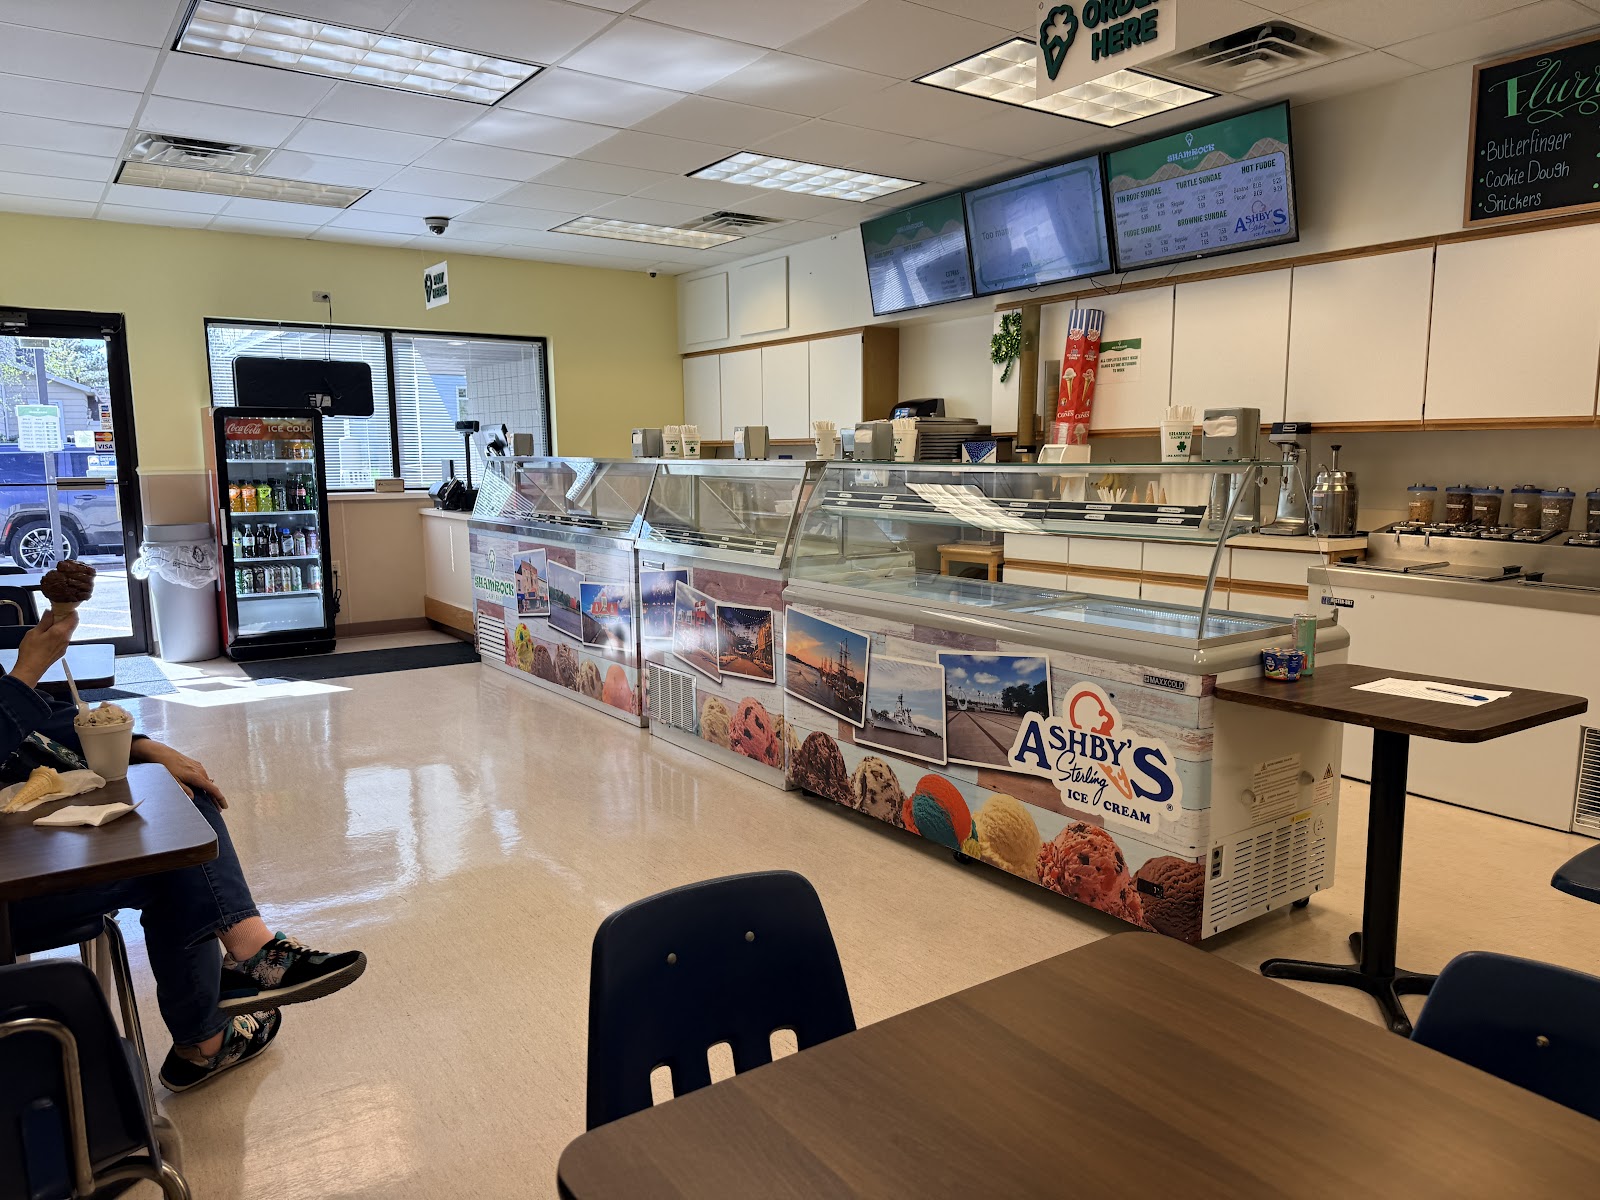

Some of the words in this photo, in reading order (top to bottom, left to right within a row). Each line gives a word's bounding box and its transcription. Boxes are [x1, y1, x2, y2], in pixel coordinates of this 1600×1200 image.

[1082, 0, 1160, 28] ORD
[1092, 9, 1159, 61] HERE
[1167, 143, 1215, 163] SHAMROCK
[1487, 129, 1572, 161] Butterfinger
[1241, 163, 1254, 174] HOT
[1256, 159, 1276, 171] FUDGE
[1486, 166, 1525, 188] Cookie
[1528, 160, 1570, 183] Dough
[1176, 178, 1198, 189] TURTLE
[1199, 172, 1222, 184] SUNDAE
[1117, 196, 1126, 204] TIN
[1127, 192, 1140, 202] ROOF
[1141, 187, 1162, 198] SUNDAE
[1484, 193, 1541, 213] Snickers
[1177, 215, 1203, 227] BROWNIE
[1204, 210, 1228, 221] SUNDAE
[1234, 208, 1287, 234] ASHBY'S
[982, 231, 994, 240] Too
[1123, 229, 1140, 238] FUDGE
[1141, 224, 1162, 235] SUNDAE
[267, 425, 284, 433] ICE
[286, 425, 312, 433] COLD
[474, 574, 515, 597] SHAMROCK
[1149, 675, 1185, 691] MAXXCOLD
[1014, 720, 1174, 802] ASHBY'S
[1056, 749, 1109, 806] Sterling
[1067, 788, 1089, 804] ICE
[1103, 800, 1151, 825] CREAM
